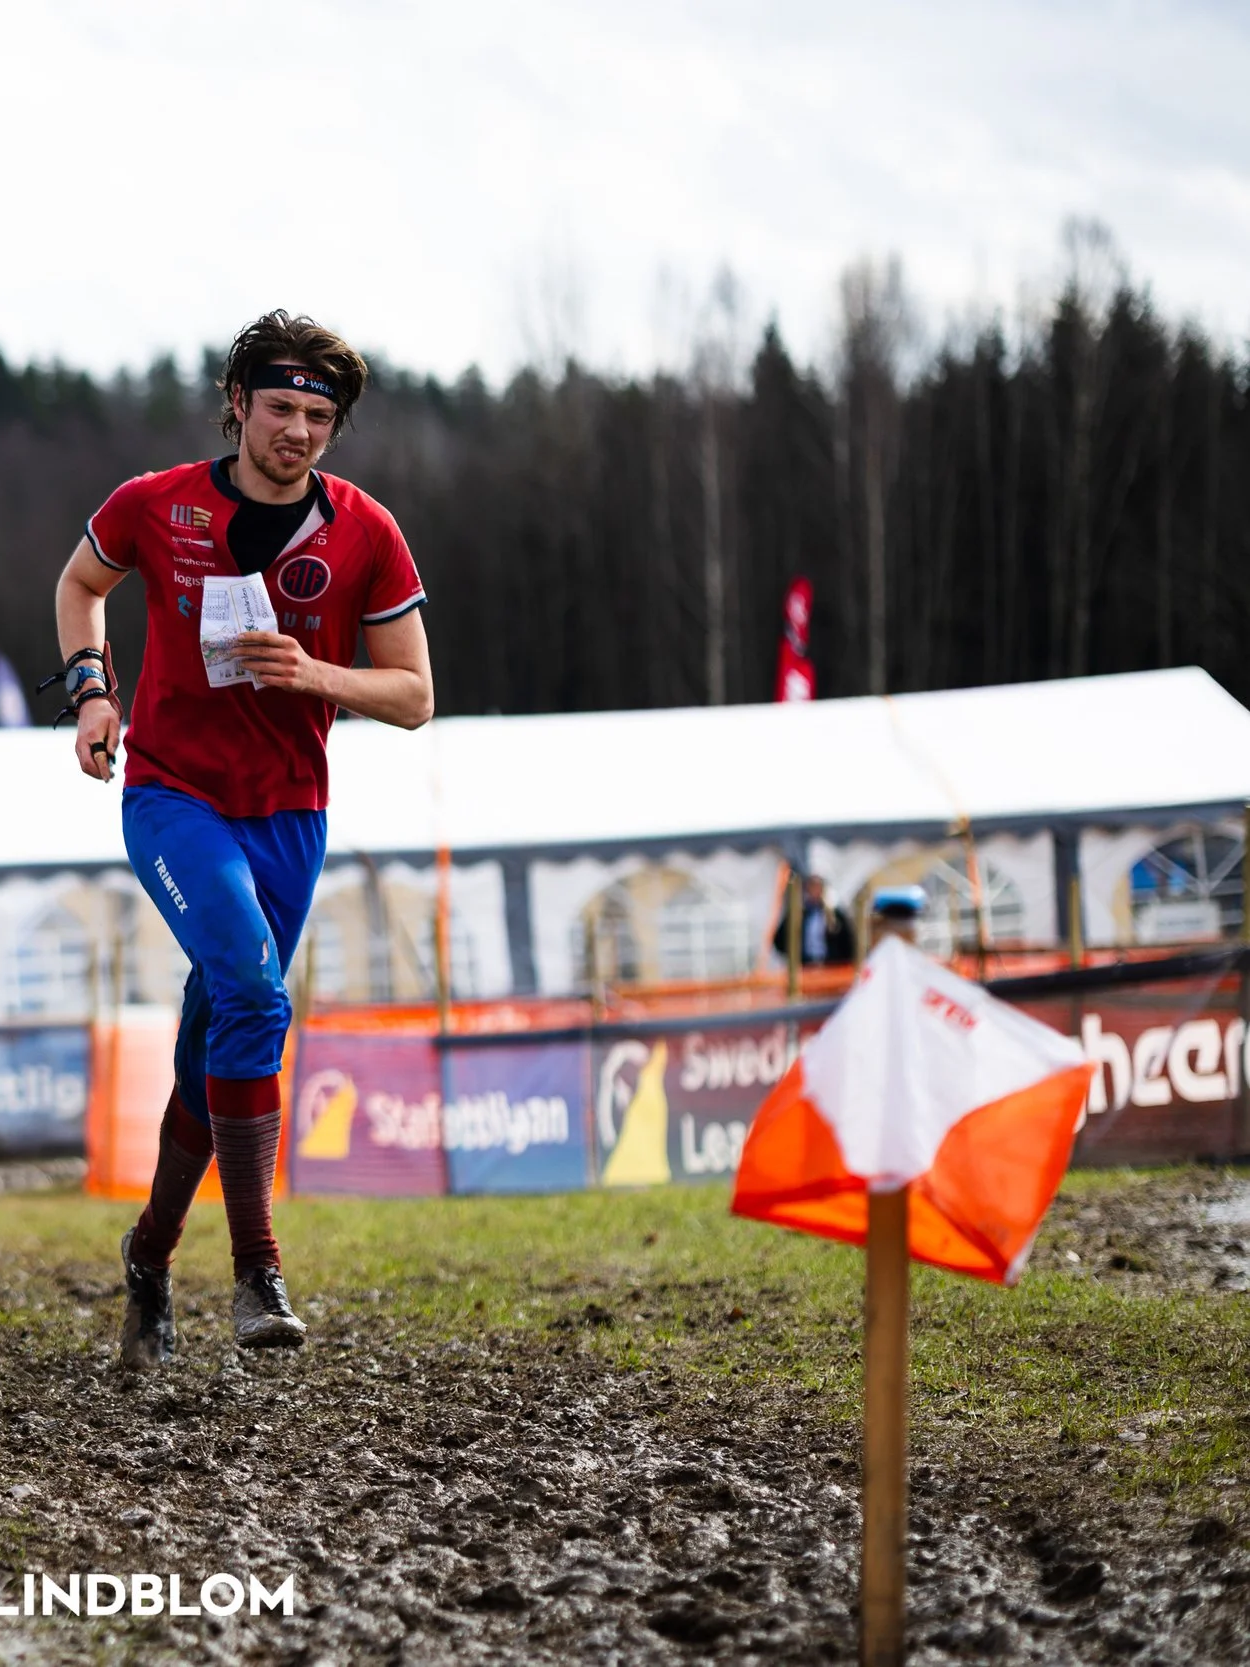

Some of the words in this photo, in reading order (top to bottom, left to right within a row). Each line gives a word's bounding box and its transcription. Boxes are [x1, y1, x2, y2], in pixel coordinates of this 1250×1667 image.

[274, 611, 322, 631] UM
[154, 855, 188, 915] TRIMTEX
[680, 1021, 810, 1092] Swedi
[1072, 1012, 1250, 1134] heer
